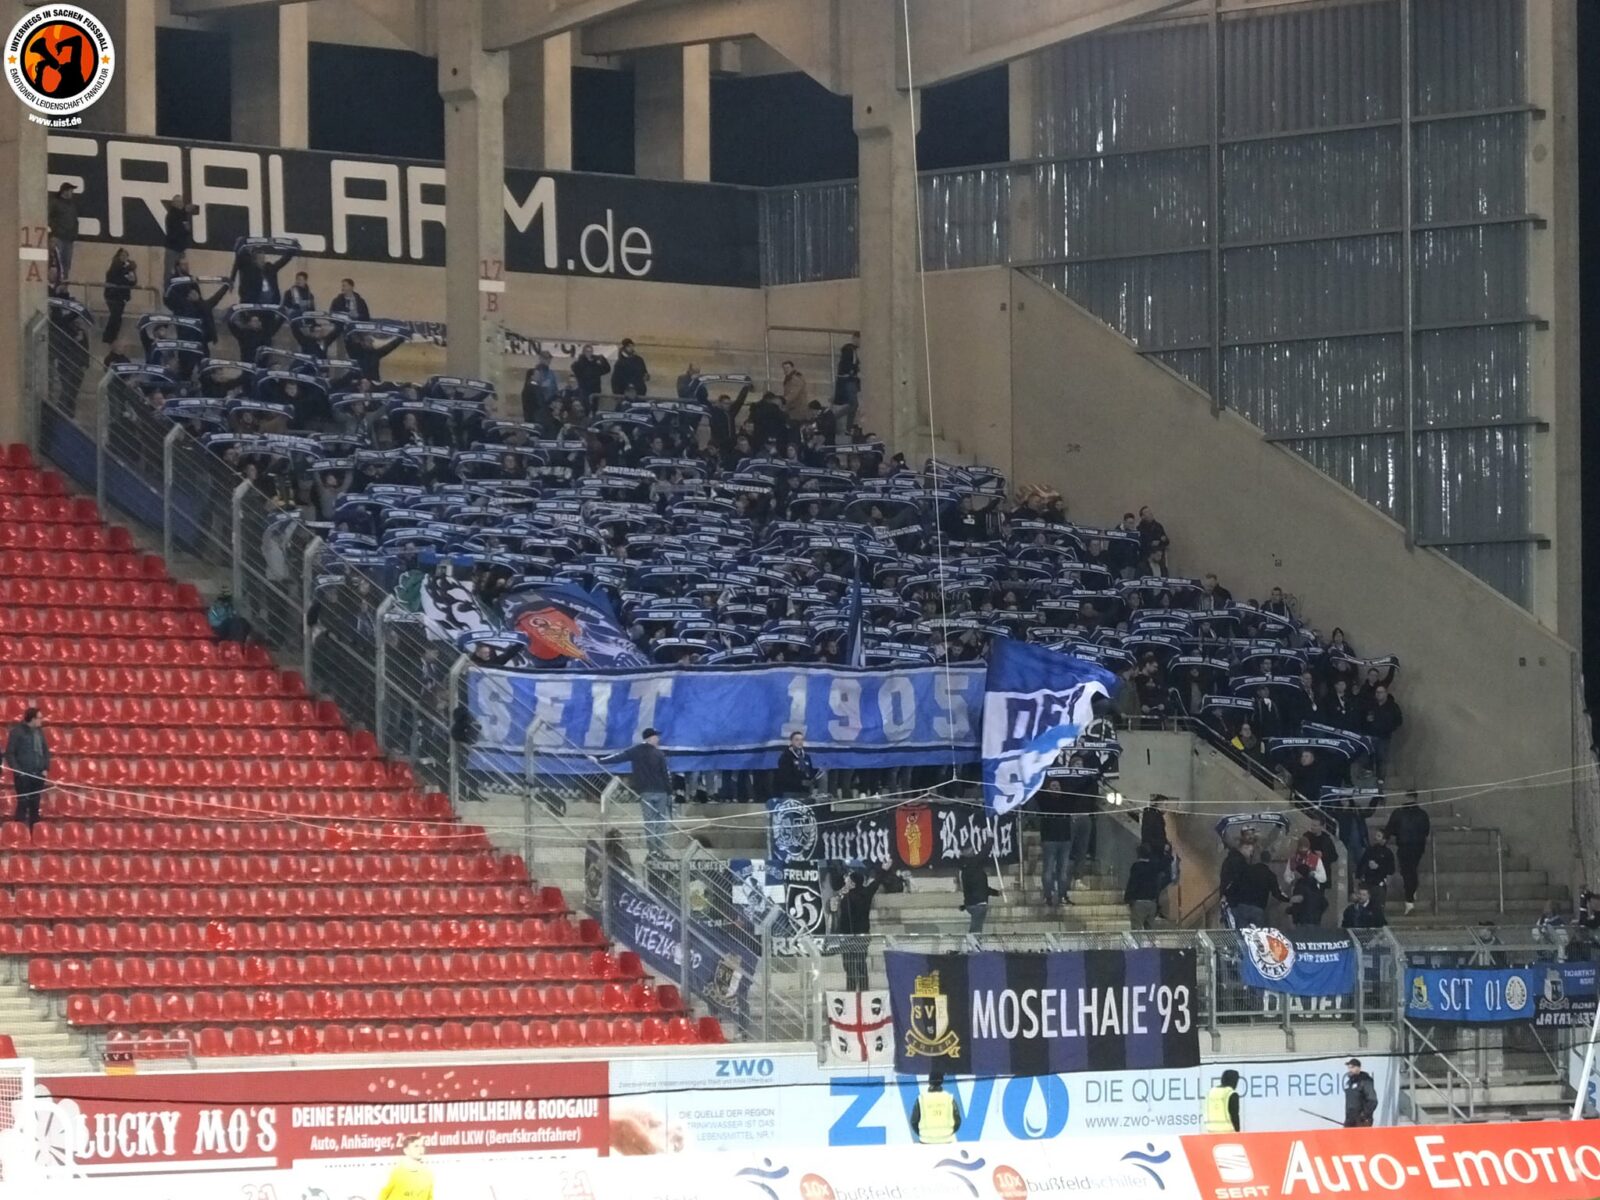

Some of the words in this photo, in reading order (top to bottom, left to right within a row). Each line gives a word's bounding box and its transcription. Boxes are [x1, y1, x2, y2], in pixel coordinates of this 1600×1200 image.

[21, 226, 46, 247] 17
[26, 262, 42, 282] A
[481, 260, 503, 280] 17
[486, 292, 499, 312] B
[477, 675, 674, 747] SEIT
[781, 673, 971, 742] 1905
[1438, 978, 1473, 1011] SCT
[1485, 979, 1502, 1011] 01
[716, 1058, 774, 1077] ZWO
[1085, 1079, 1124, 1103] DIE
[292, 1106, 335, 1128] DEINE
[337, 1103, 427, 1126] FAHRSCHULE
[429, 1102, 445, 1123] IN
[524, 1099, 537, 1121] &
[538, 1098, 599, 1120] RODGAU!
[694, 1109, 725, 1119] QUELLE
[726, 1109, 743, 1117] DER
[745, 1108, 775, 1117] REGION
[75, 1111, 181, 1158] LUCKY
[310, 1135, 339, 1151] Auto,
[341, 1133, 394, 1152] Anhänger,
[440, 1131, 460, 1146] und
[461, 1129, 484, 1145] LKW
[486, 1126, 582, 1146] (Berufskraftfahrer)
[1215, 1185, 1270, 1200] SEAT
